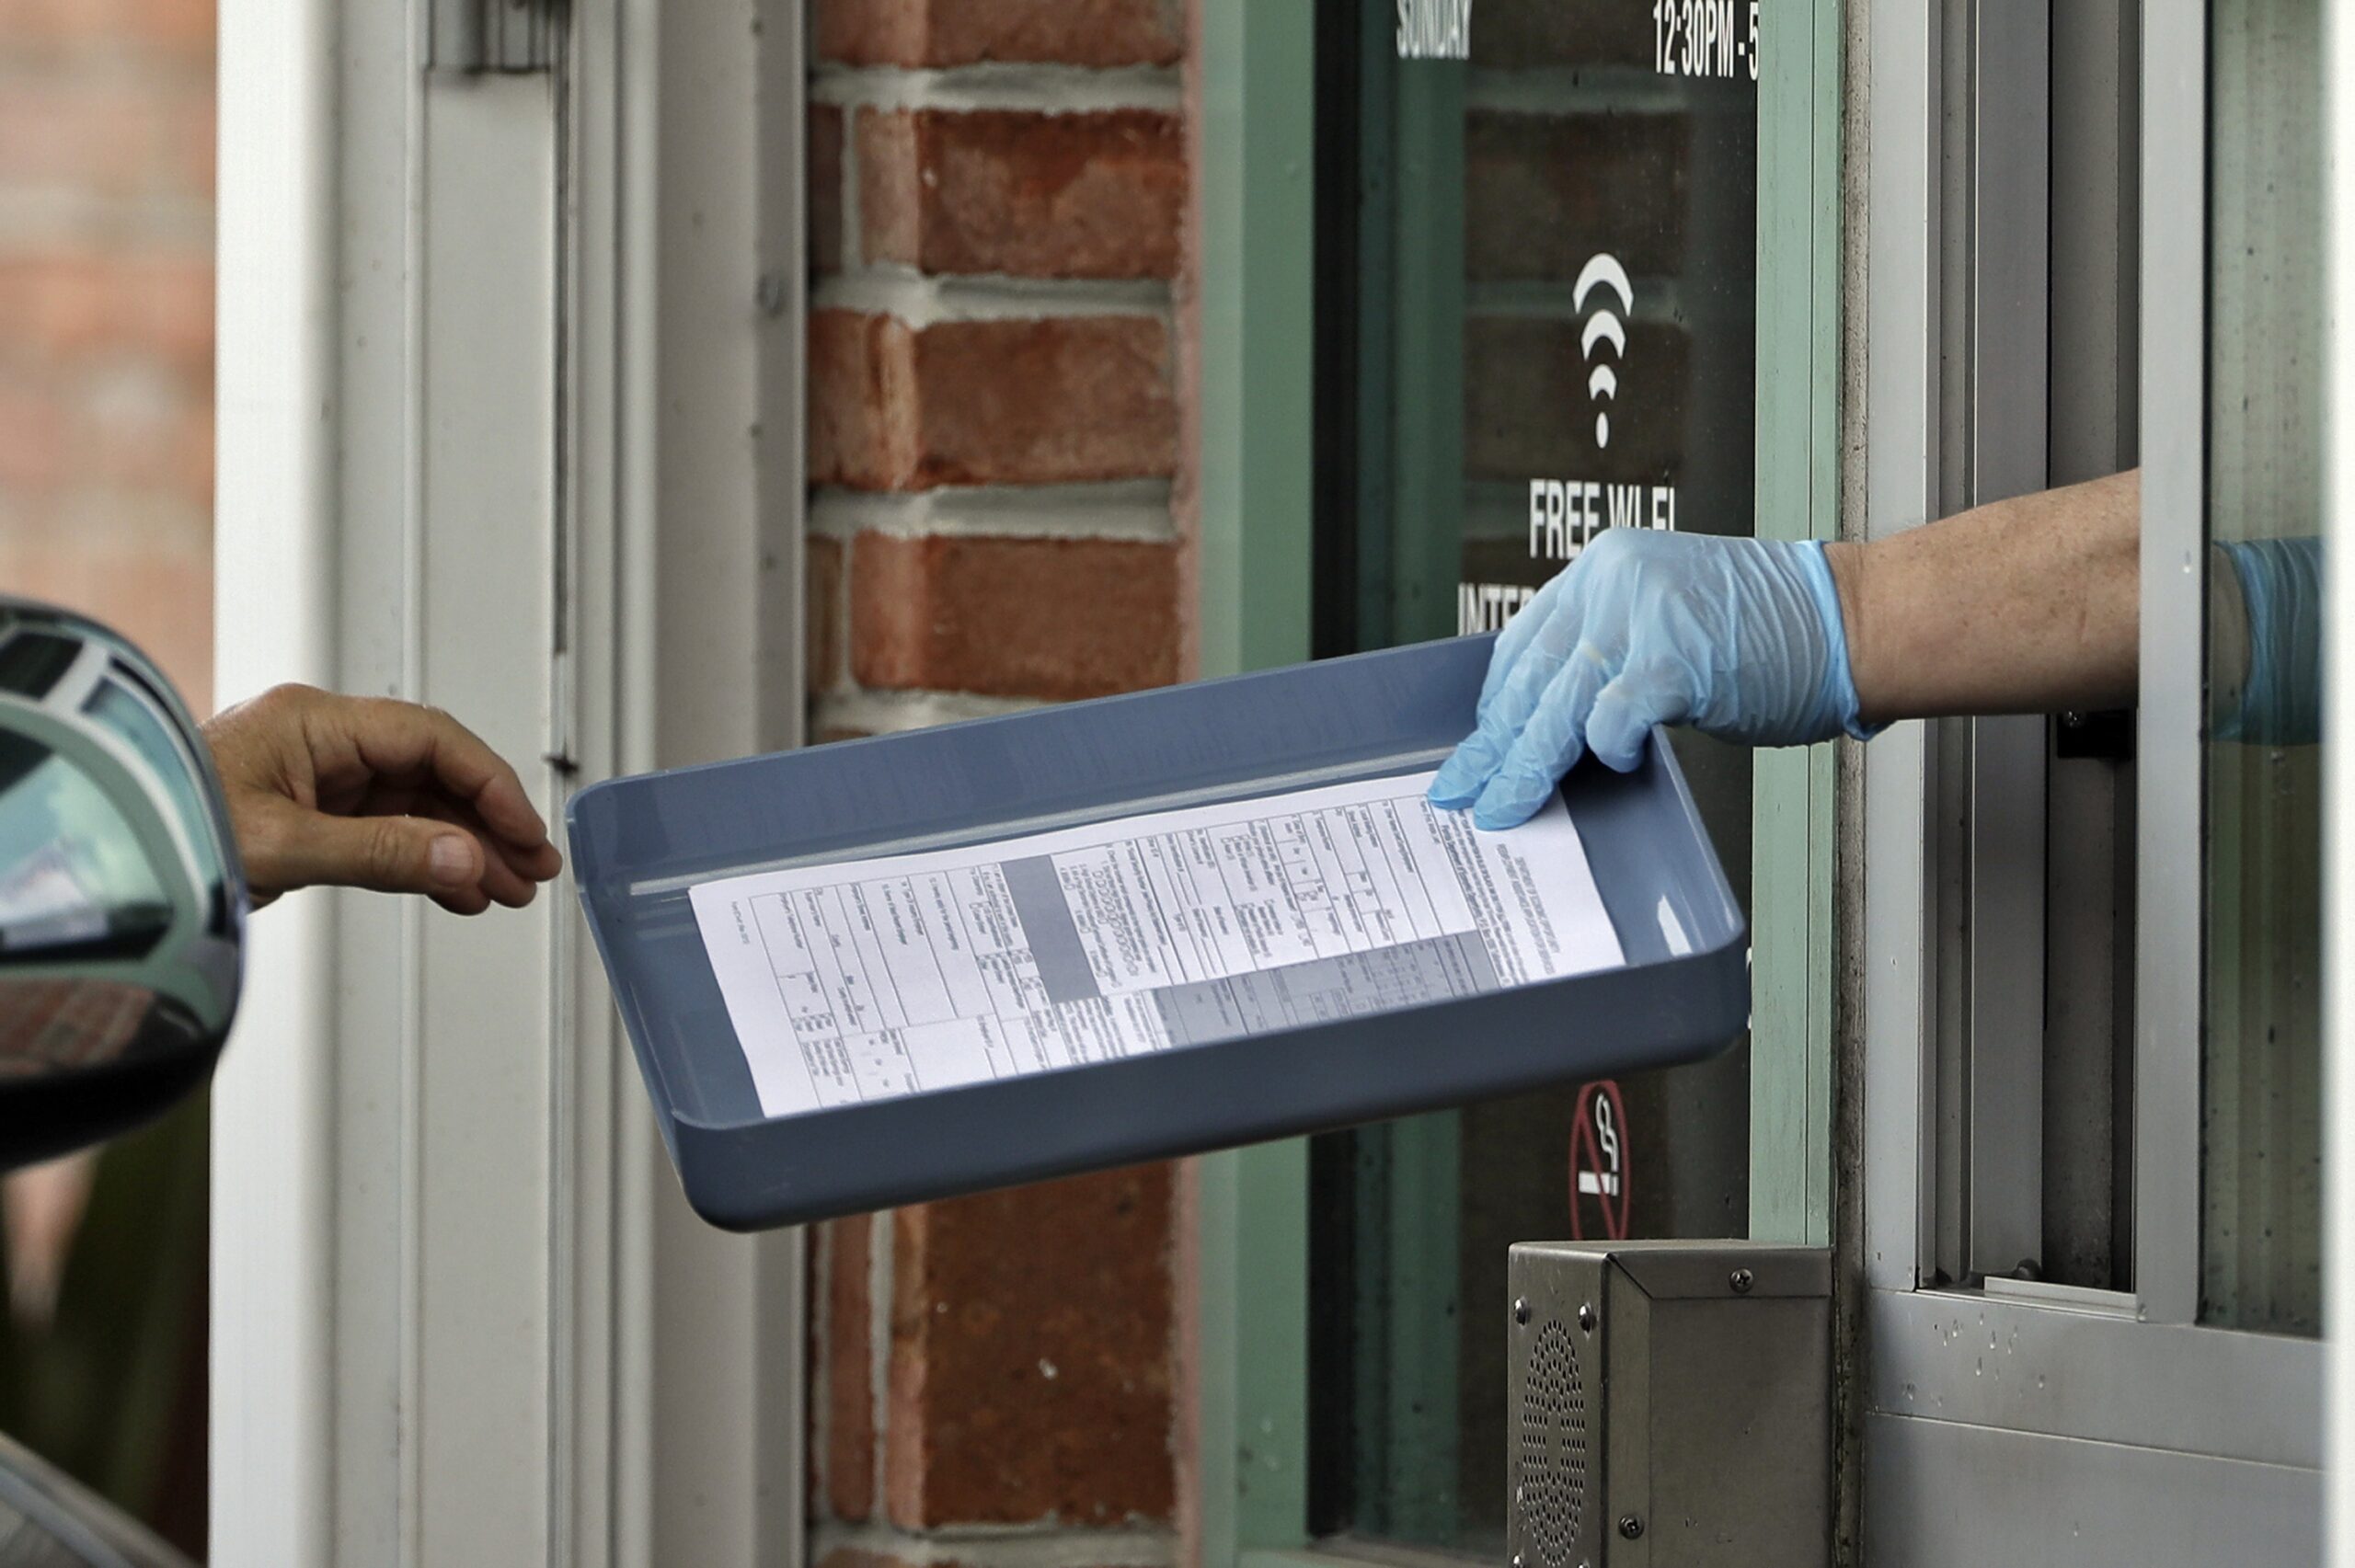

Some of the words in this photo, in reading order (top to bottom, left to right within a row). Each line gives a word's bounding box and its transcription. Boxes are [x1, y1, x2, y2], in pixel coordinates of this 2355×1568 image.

[1396, 0, 1472, 60] SUNDAY
[1653, 0, 1734, 78] 12:30PM
[1529, 477, 1601, 560] FREE
[1607, 483, 1675, 532] WIFI
